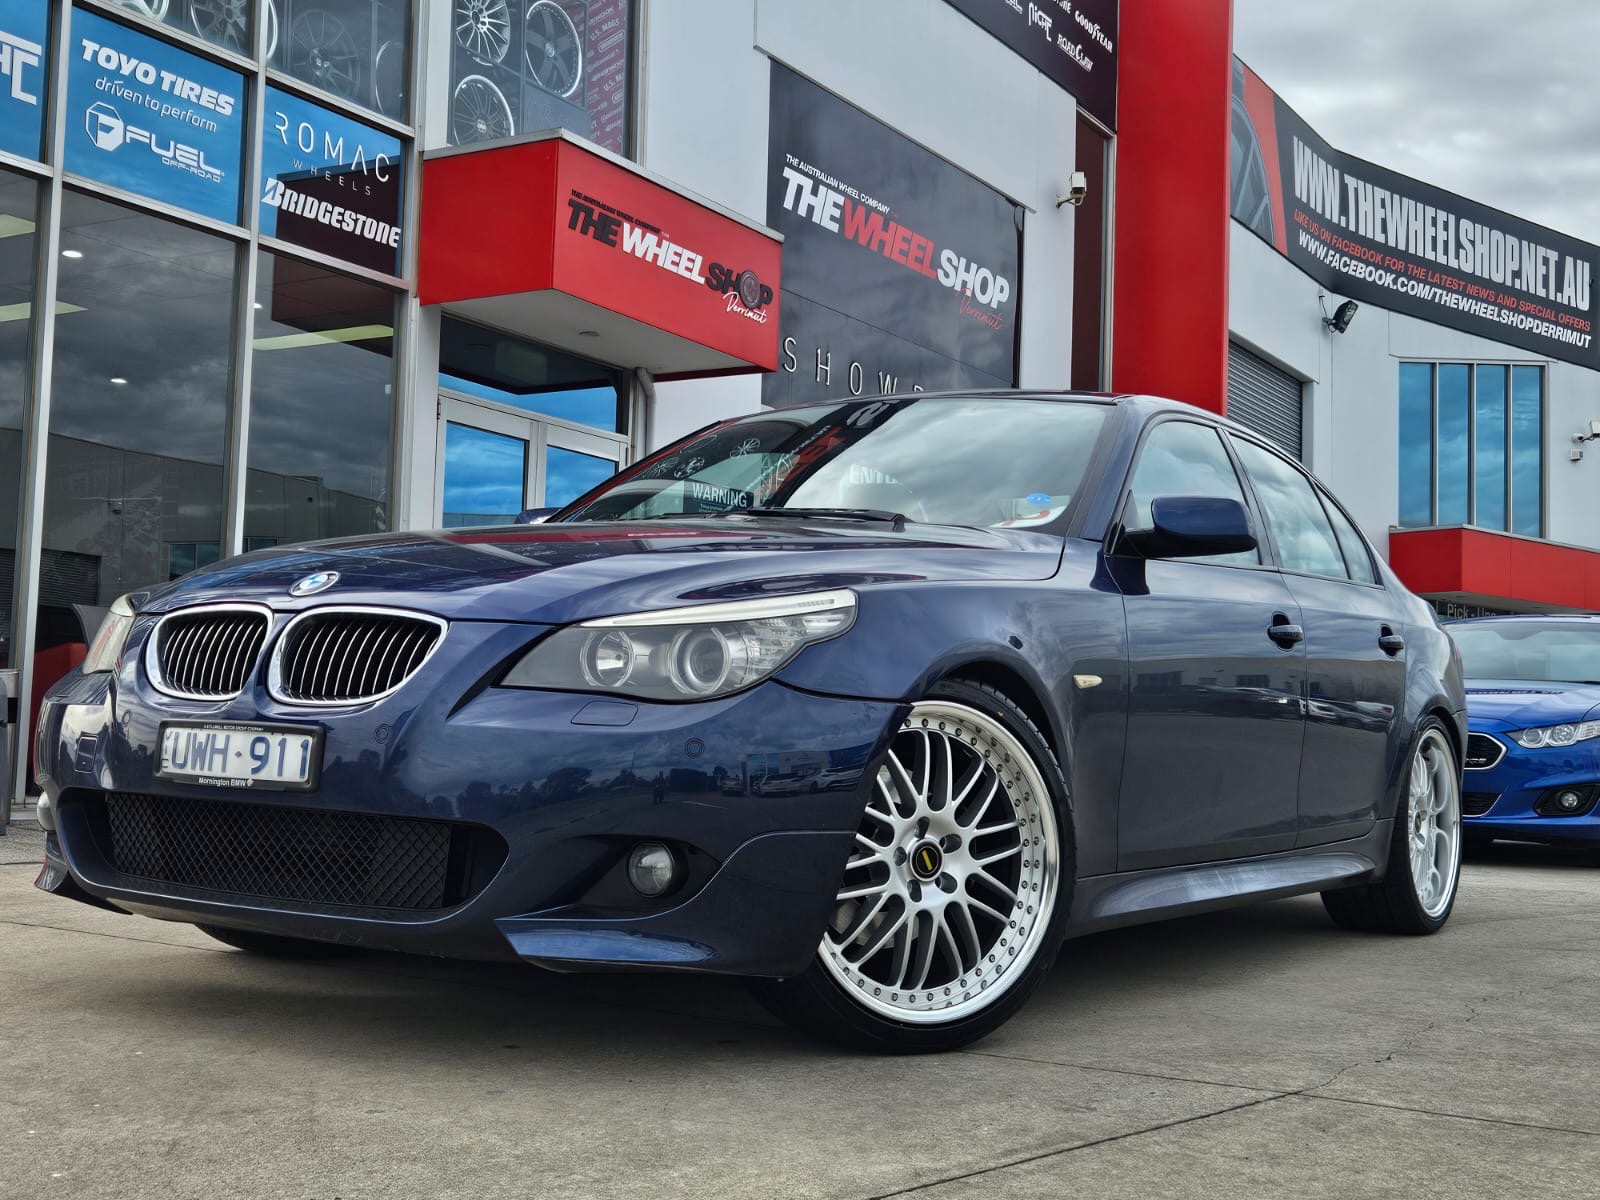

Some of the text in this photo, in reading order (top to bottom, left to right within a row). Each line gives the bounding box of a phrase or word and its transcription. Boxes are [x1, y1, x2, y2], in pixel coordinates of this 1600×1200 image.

[1075, 10, 1112, 53] GOODYEAR
[81, 38, 235, 116] TOYO TIRES
[95, 77, 217, 133] driven to perform
[125, 125, 221, 176] FUEL
[161, 157, 221, 183] OFF-ROAD
[275, 111, 390, 183] ROMAC
[293, 159, 371, 196] WHEELS
[262, 177, 401, 248] BRIDGESTONE
[785, 153, 891, 215] THE AUSTRALIAN WHEEL COMPANY
[568, 198, 622, 249] THE
[622, 222, 706, 285] WHEEL
[782, 166, 1010, 310] THE WHEEL SHOP
[1293, 135, 1590, 312] WWW.THEWHEELSHOP.NET.AU
[1294, 208, 1591, 332] LIKE US ON FACEBOOK FOR THE LATEST NEWS AND SPECIAL OFFERS
[1299, 229, 1592, 348] WWW.FACEBOOK.COM/THEWHEELSHOPDERRIMUT
[783, 336, 925, 396] SHOW
[692, 482, 748, 508] WARNING
[1447, 603, 1469, 620] Pick
[230, 778, 247, 787] BMW
